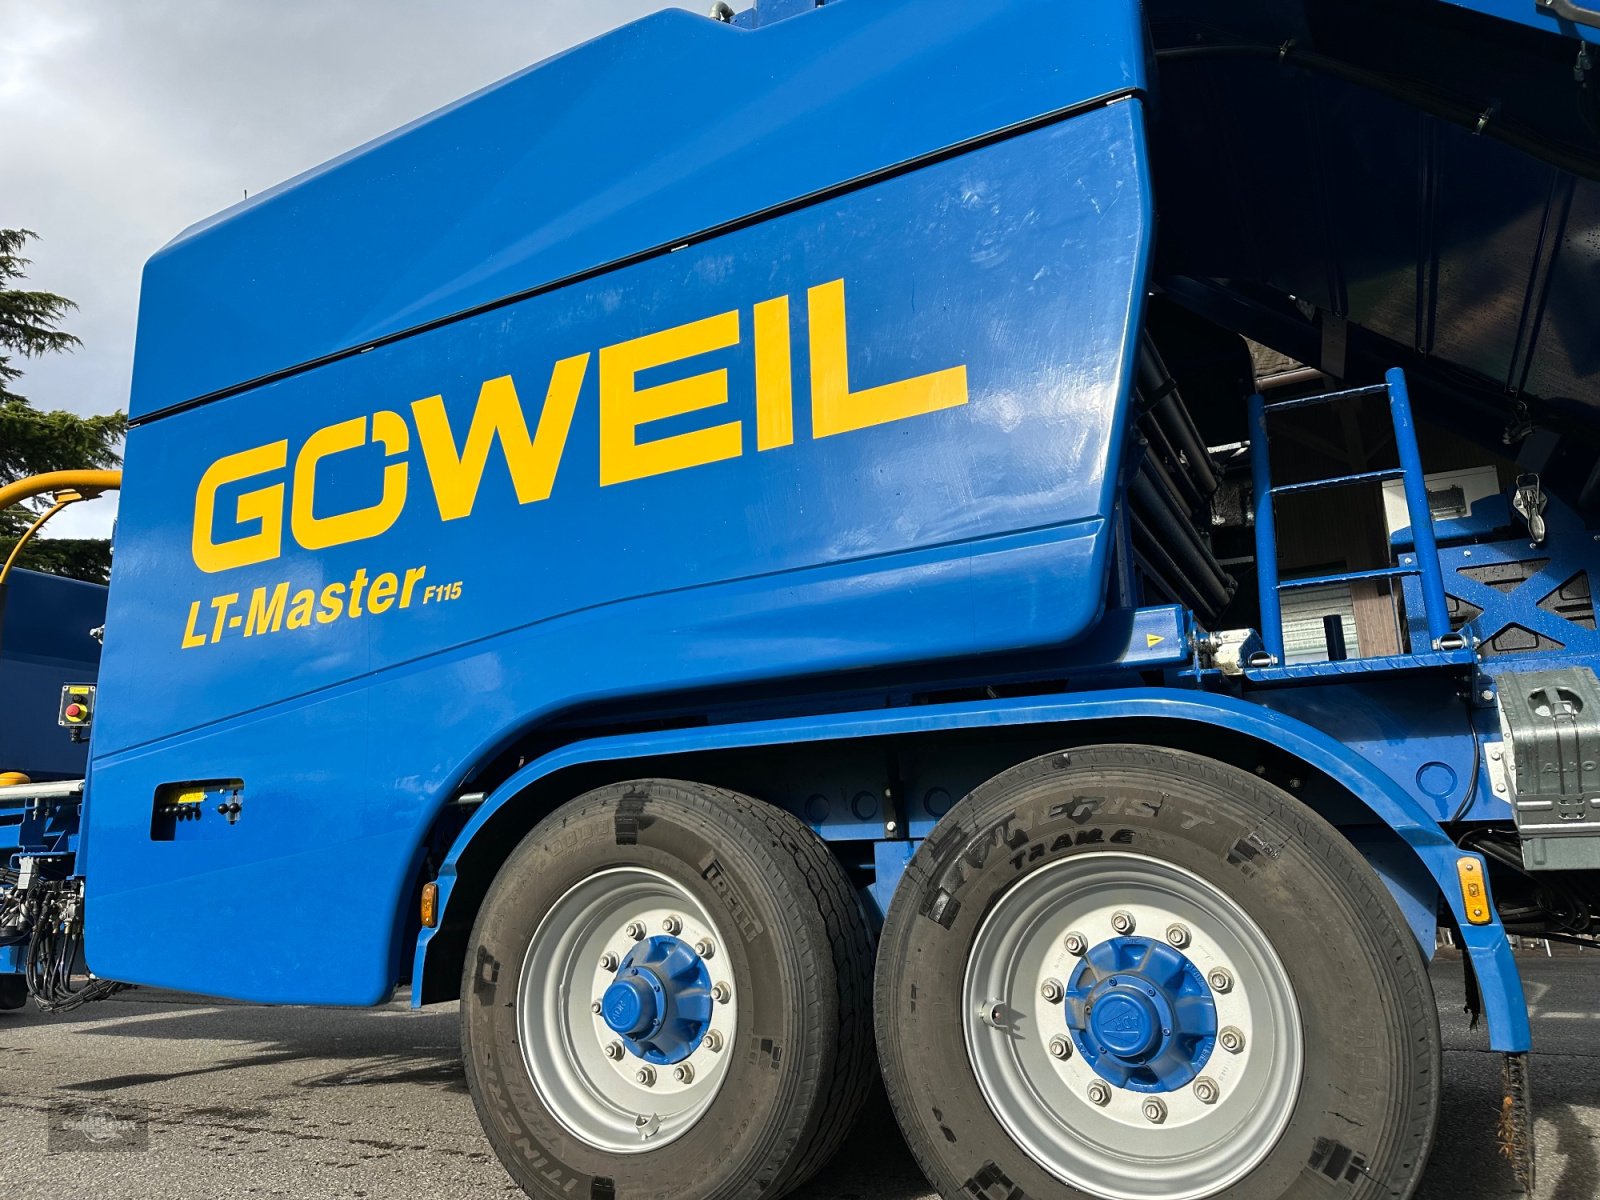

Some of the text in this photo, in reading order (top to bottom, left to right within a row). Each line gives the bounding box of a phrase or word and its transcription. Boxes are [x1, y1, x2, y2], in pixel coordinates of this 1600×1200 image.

[191, 278, 969, 574] GOWEIL
[181, 565, 464, 649] LT-Master F115
